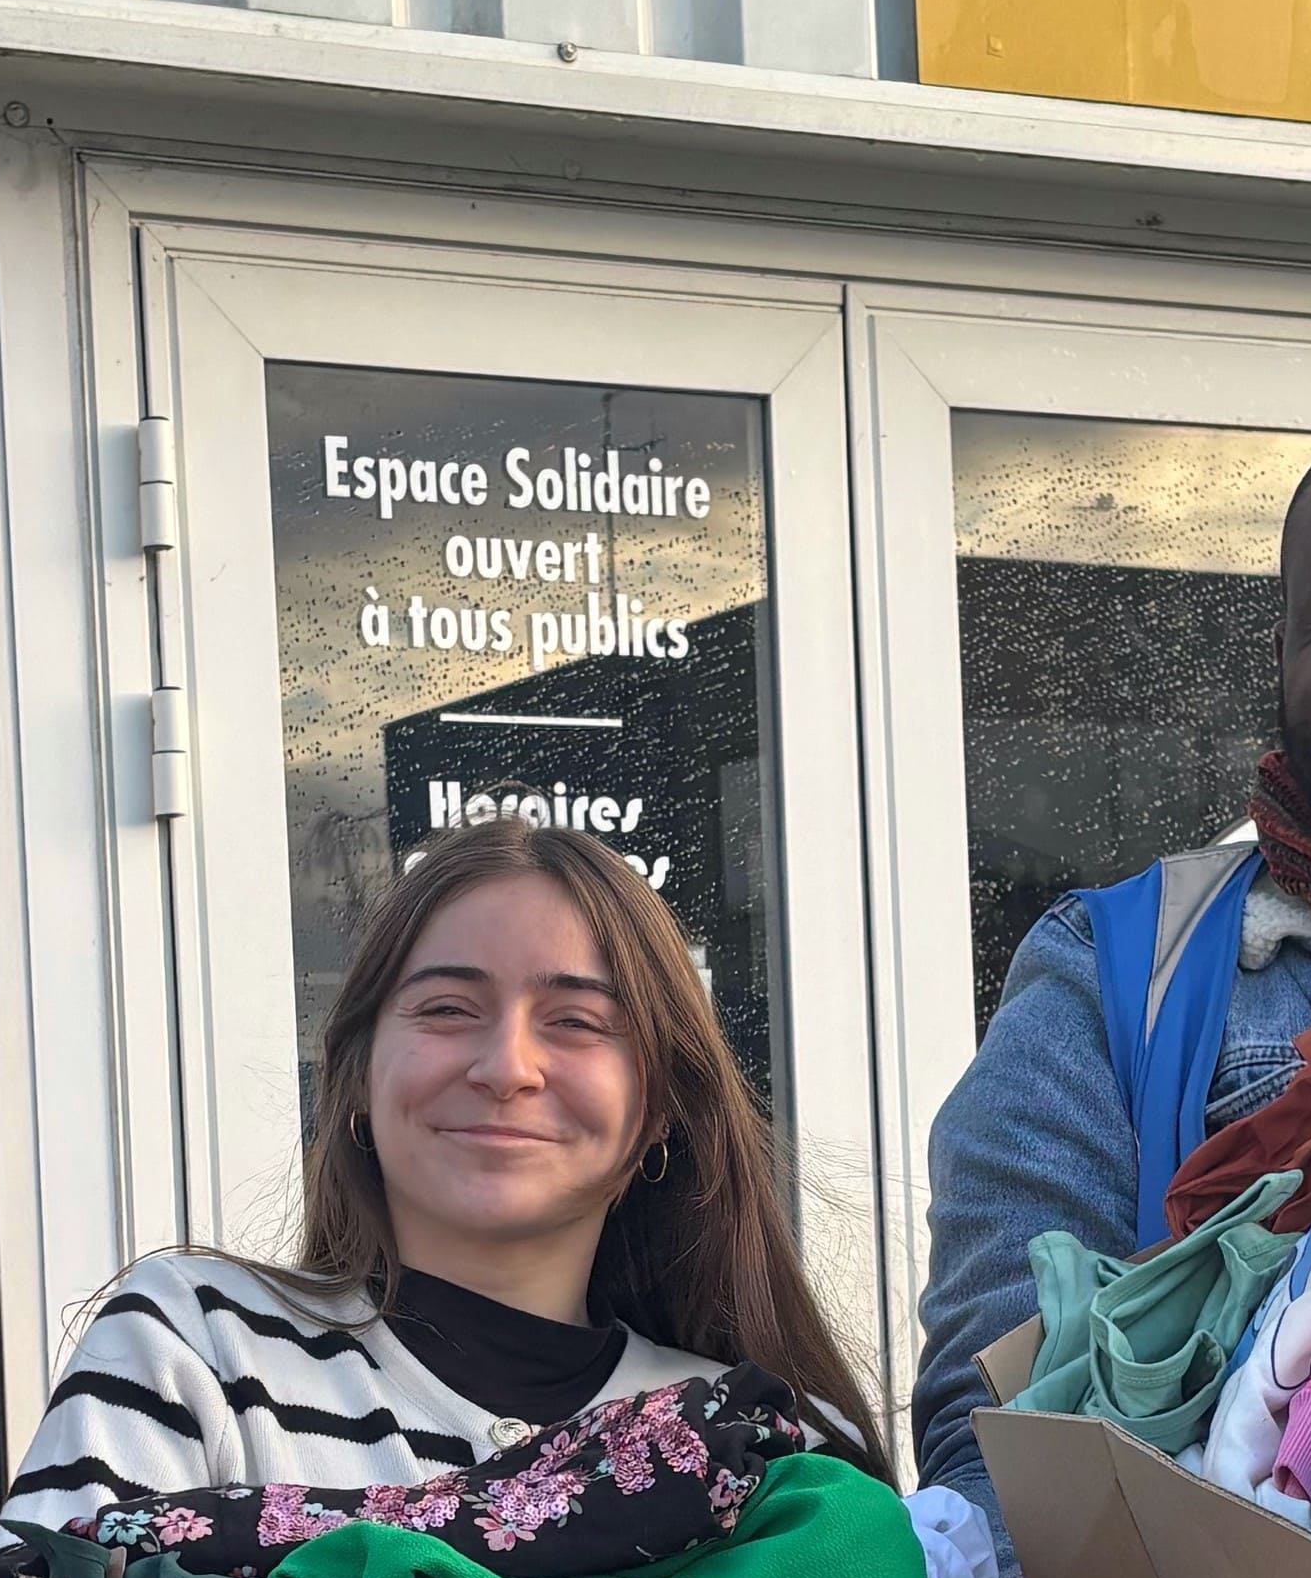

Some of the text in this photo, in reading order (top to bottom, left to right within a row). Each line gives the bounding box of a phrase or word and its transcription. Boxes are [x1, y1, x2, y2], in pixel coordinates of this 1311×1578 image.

[324, 436, 711, 520] Espace Solidaire
[445, 532, 602, 583] ouvert
[361, 587, 690, 672] à tous publics
